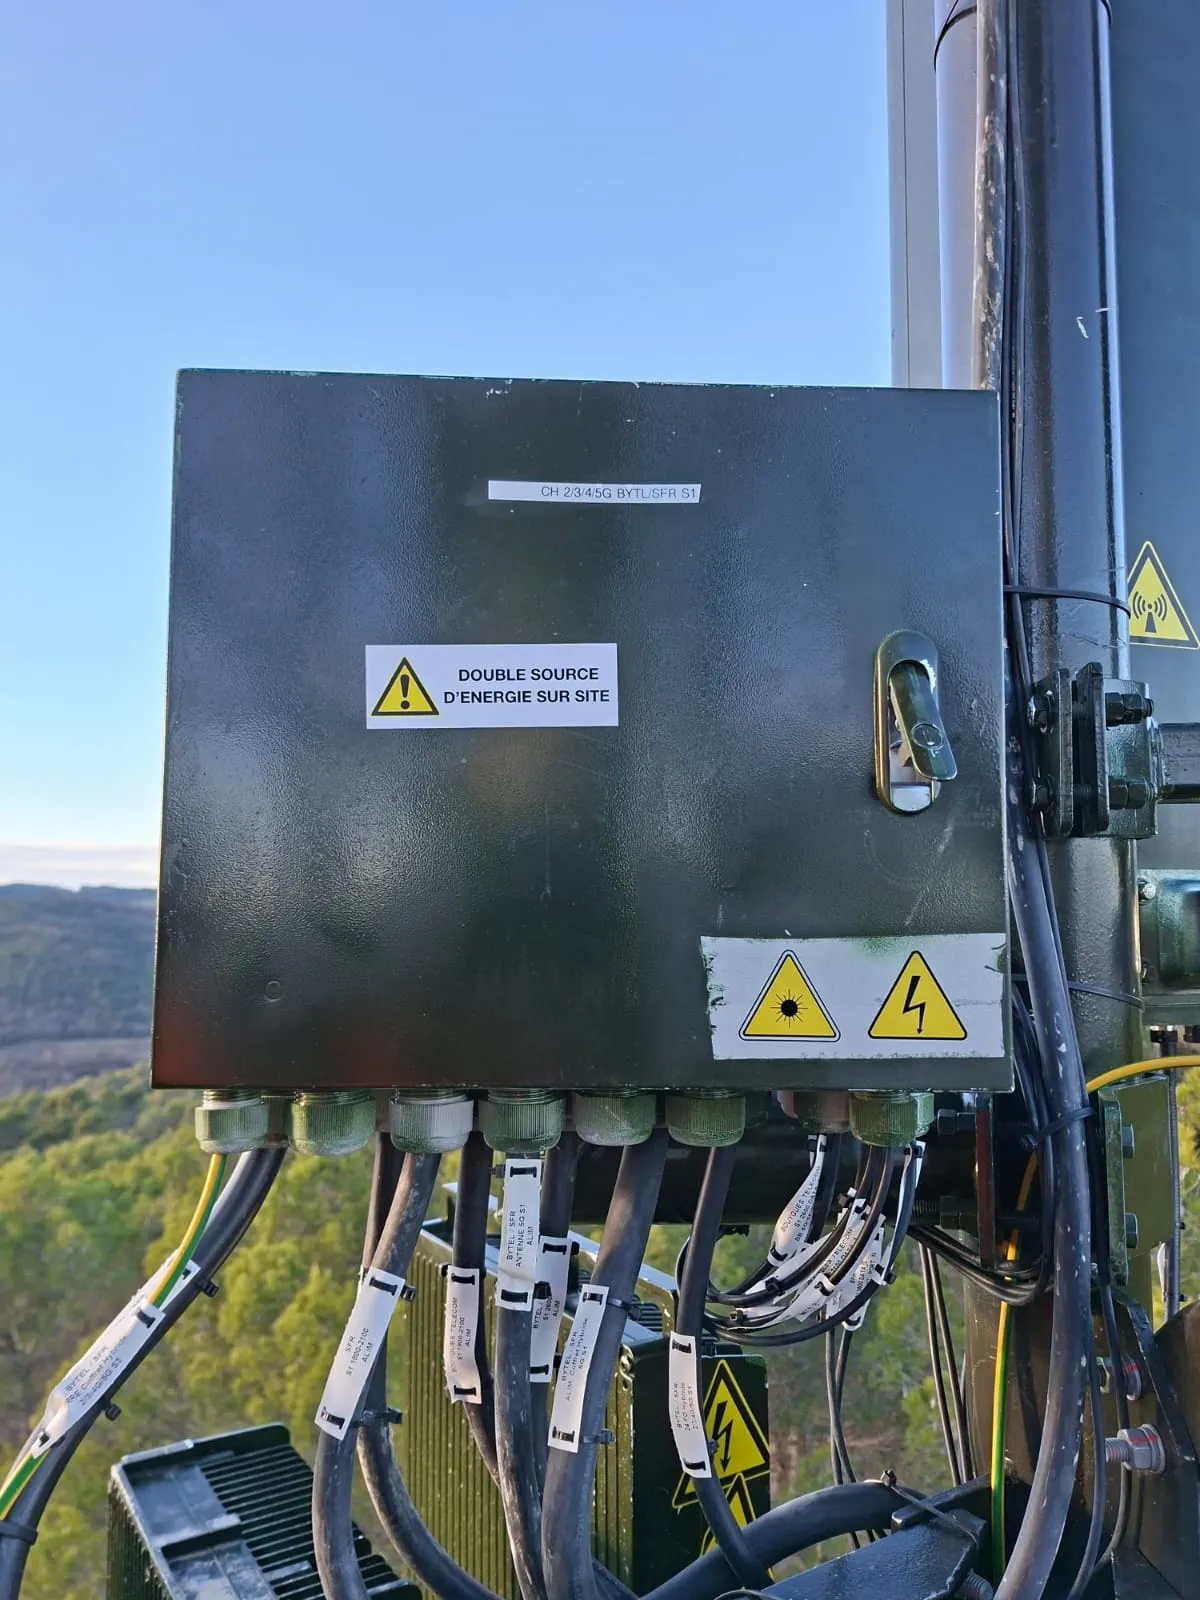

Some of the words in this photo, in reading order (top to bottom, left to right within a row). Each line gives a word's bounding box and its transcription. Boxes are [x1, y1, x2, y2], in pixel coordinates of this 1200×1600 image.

[541, 486, 559, 497] CH
[563, 487, 612, 498] 2/3/4/5G
[617, 488, 677, 499] BYTL/SFR
[681, 488, 696, 499] S1
[458, 669, 526, 681] DOUBLE
[530, 668, 599, 681] SOURCE
[443, 691, 532, 703] D'ENERGIE
[536, 691, 570, 703] SUR
[574, 690, 610, 702] SITE
[781, 1199, 805, 1232] BOUYGUES
[506, 1234, 515, 1261] BYTEL
[515, 1229, 525, 1267] ANTENNE
[552, 1300, 560, 1317] ALIM
[345, 1336, 355, 1352] SFR
[362, 1342, 373, 1362] ALIM
